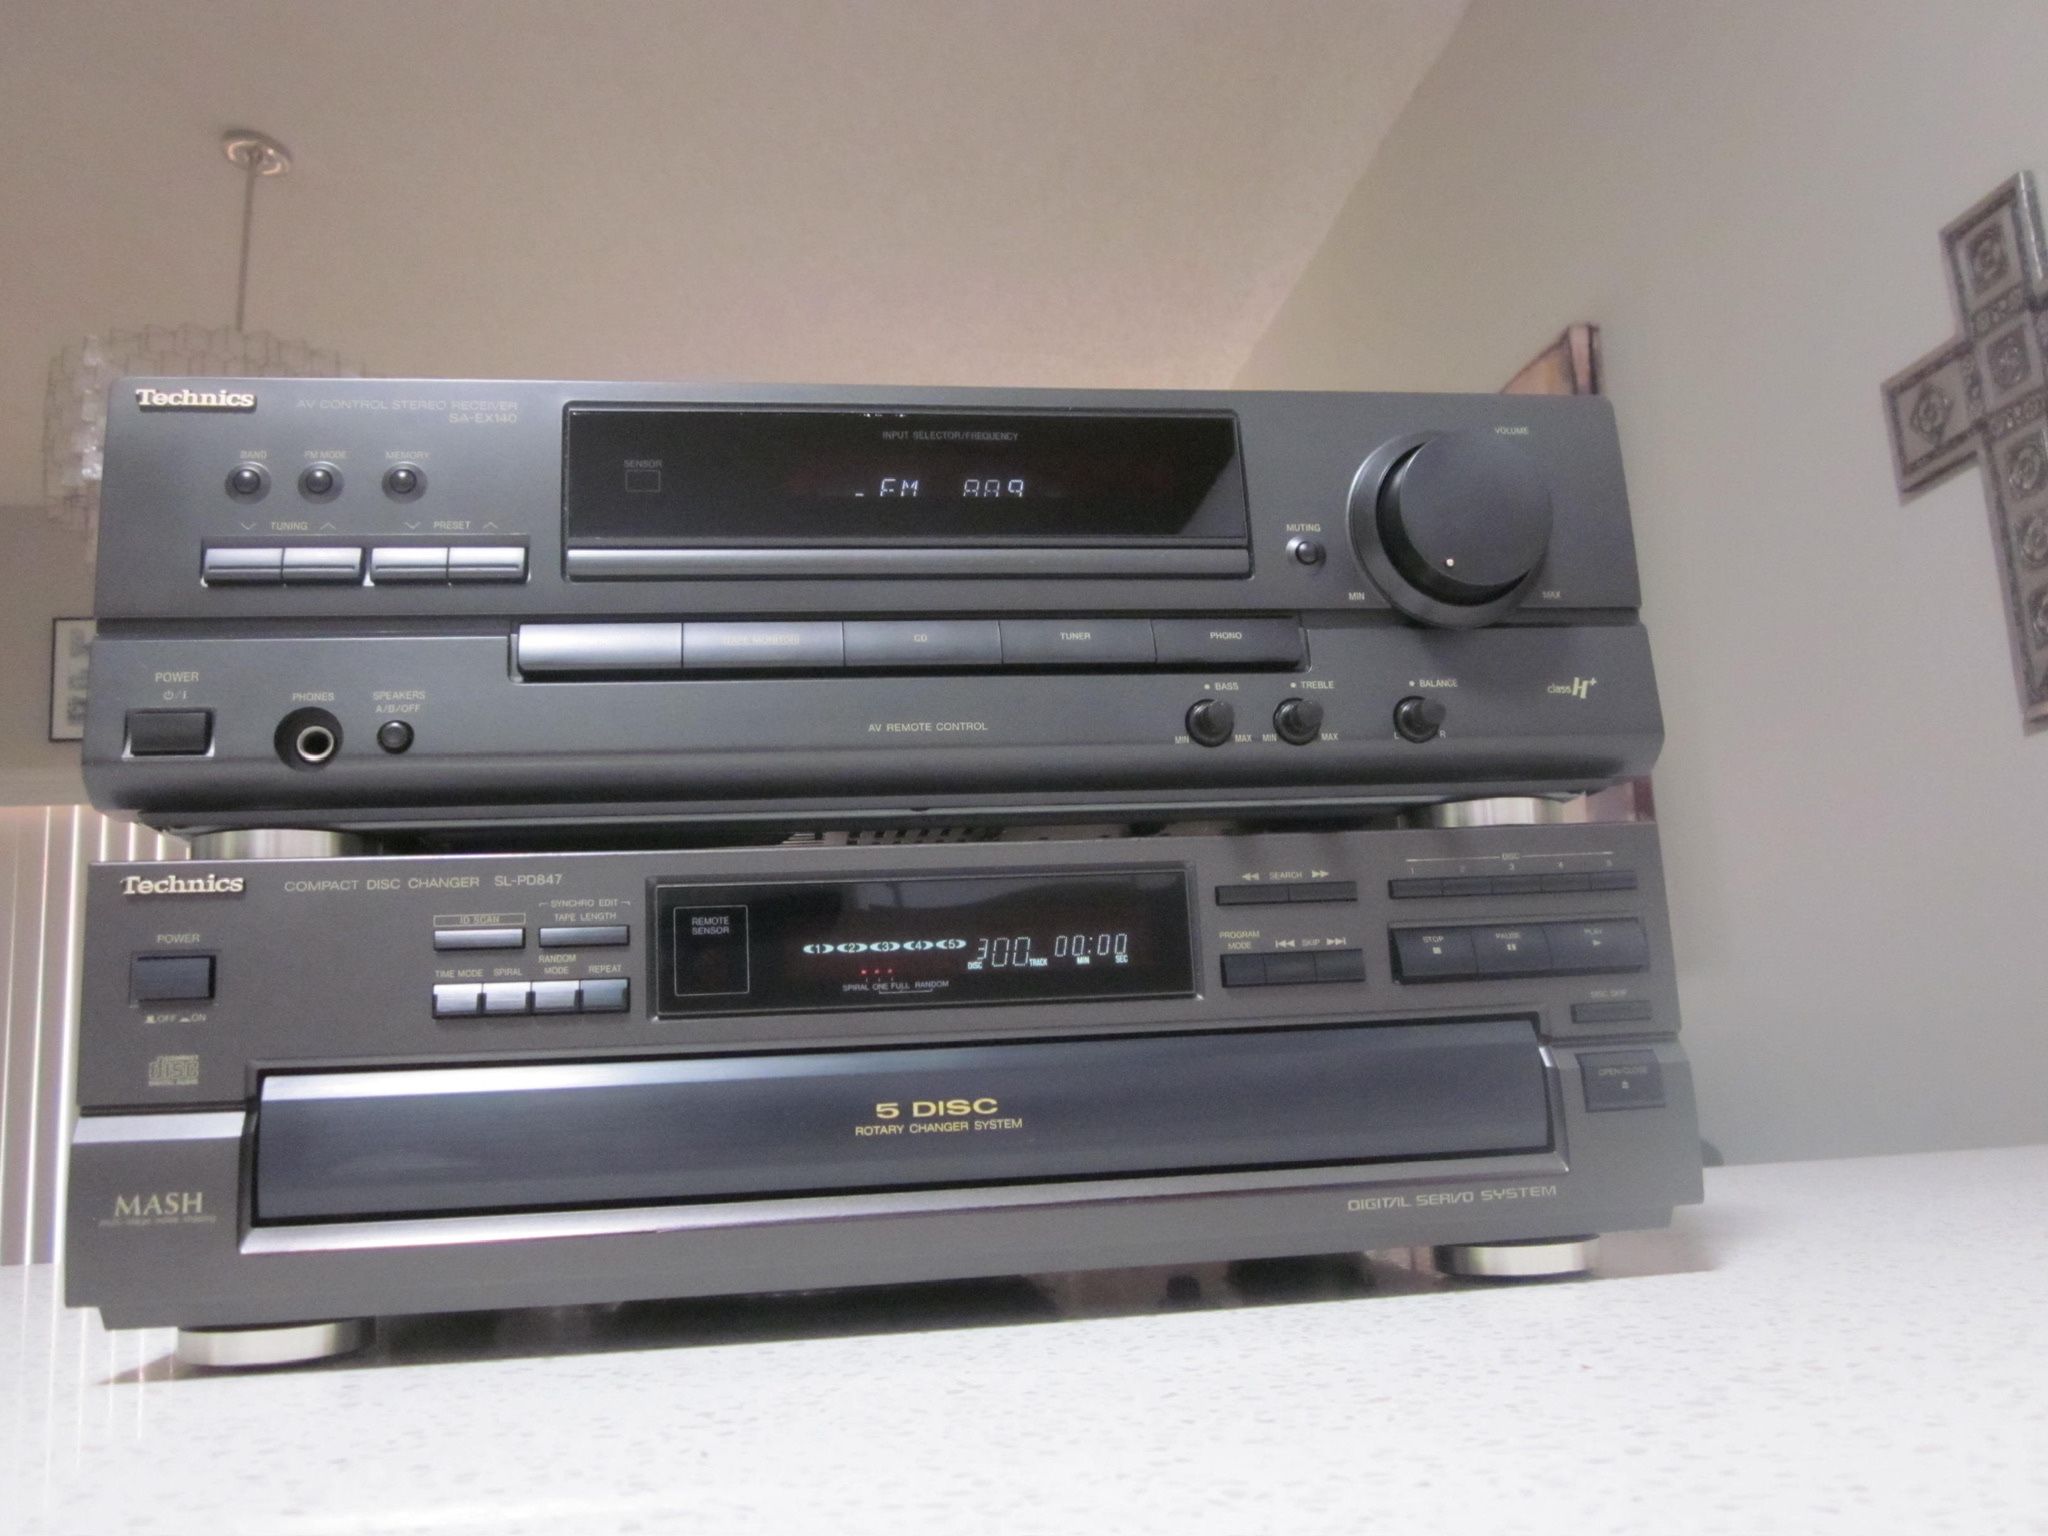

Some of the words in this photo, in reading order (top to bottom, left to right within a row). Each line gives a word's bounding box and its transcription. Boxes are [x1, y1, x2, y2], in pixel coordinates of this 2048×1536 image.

[136, 389, 255, 409] Technics
[320, 401, 388, 411] CONTROL
[392, 401, 447, 411] STEREO
[451, 401, 518, 411] RECEIVER
[883, 430, 909, 440] INPUT
[1494, 426, 1529, 436] VOLUME
[880, 478, 919, 497] FM
[271, 521, 308, 531] TUNING
[433, 520, 470, 531] PRESET
[1286, 523, 1321, 533] MUTING
[1348, 592, 1365, 601] MIN
[1060, 632, 1091, 640] TUNER
[1209, 632, 1242, 640] PHONO
[155, 672, 199, 682] POWER
[1214, 682, 1239, 691] BASS
[1301, 680, 1335, 690] TREBLE
[1419, 678, 1459, 688] BALANCE
[292, 691, 334, 702] PHONES
[372, 691, 425, 701] SPEAKERS
[868, 724, 881, 733] AV
[886, 723, 932, 733] REMOTE
[935, 722, 988, 732] CONTROL
[1174, 736, 1190, 744] MIN
[1235, 734, 1252, 743] MAX
[1262, 734, 1277, 742] MIN
[1321, 732, 1339, 741] MAX
[1269, 870, 1303, 880] SEARCH
[123, 875, 244, 896] Technics
[284, 880, 359, 893] COMPACT
[366, 879, 401, 891] DISC
[408, 876, 479, 890] CHANGER
[494, 873, 563, 888] SL-PD847
[598, 898, 618, 907] EDIT
[554, 912, 577, 922] TAPE
[580, 911, 617, 921] LENGTH
[691, 917, 729, 926] REMOTE
[692, 926, 730, 935] SENSOR
[1219, 930, 1260, 939] PROGRAM
[156, 933, 201, 944] POWER
[1302, 938, 1321, 947] SKIP
[1422, 935, 1444, 943] STOP
[1054, 933, 1128, 958] 00:00
[1227, 941, 1252, 950] MODE
[538, 954, 576, 963] RANDOM
[1029, 958, 1048, 967] TRACK
[435, 970, 454, 978] TIME
[457, 969, 483, 978] MODE
[493, 968, 522, 977] SPIRAL
[544, 966, 569, 975] MODE
[588, 965, 622, 974] REPEAT
[842, 982, 869, 991] SPIRAL
[872, 982, 888, 991] ONE
[891, 981, 910, 990] FULL
[915, 979, 949, 989] RANDOM
[875, 1102, 900, 1119] 5
[912, 1098, 999, 1117] DISC
[855, 1124, 905, 1137] ROTARY
[909, 1121, 970, 1135] CHANGER
[974, 1119, 1023, 1132] SYSTEM
[1347, 1195, 1411, 1213] DIGITAL
[1416, 1191, 1474, 1209] SERVO
[1480, 1185, 1557, 1202] SYSTEM
[114, 1191, 204, 1218] MASH
